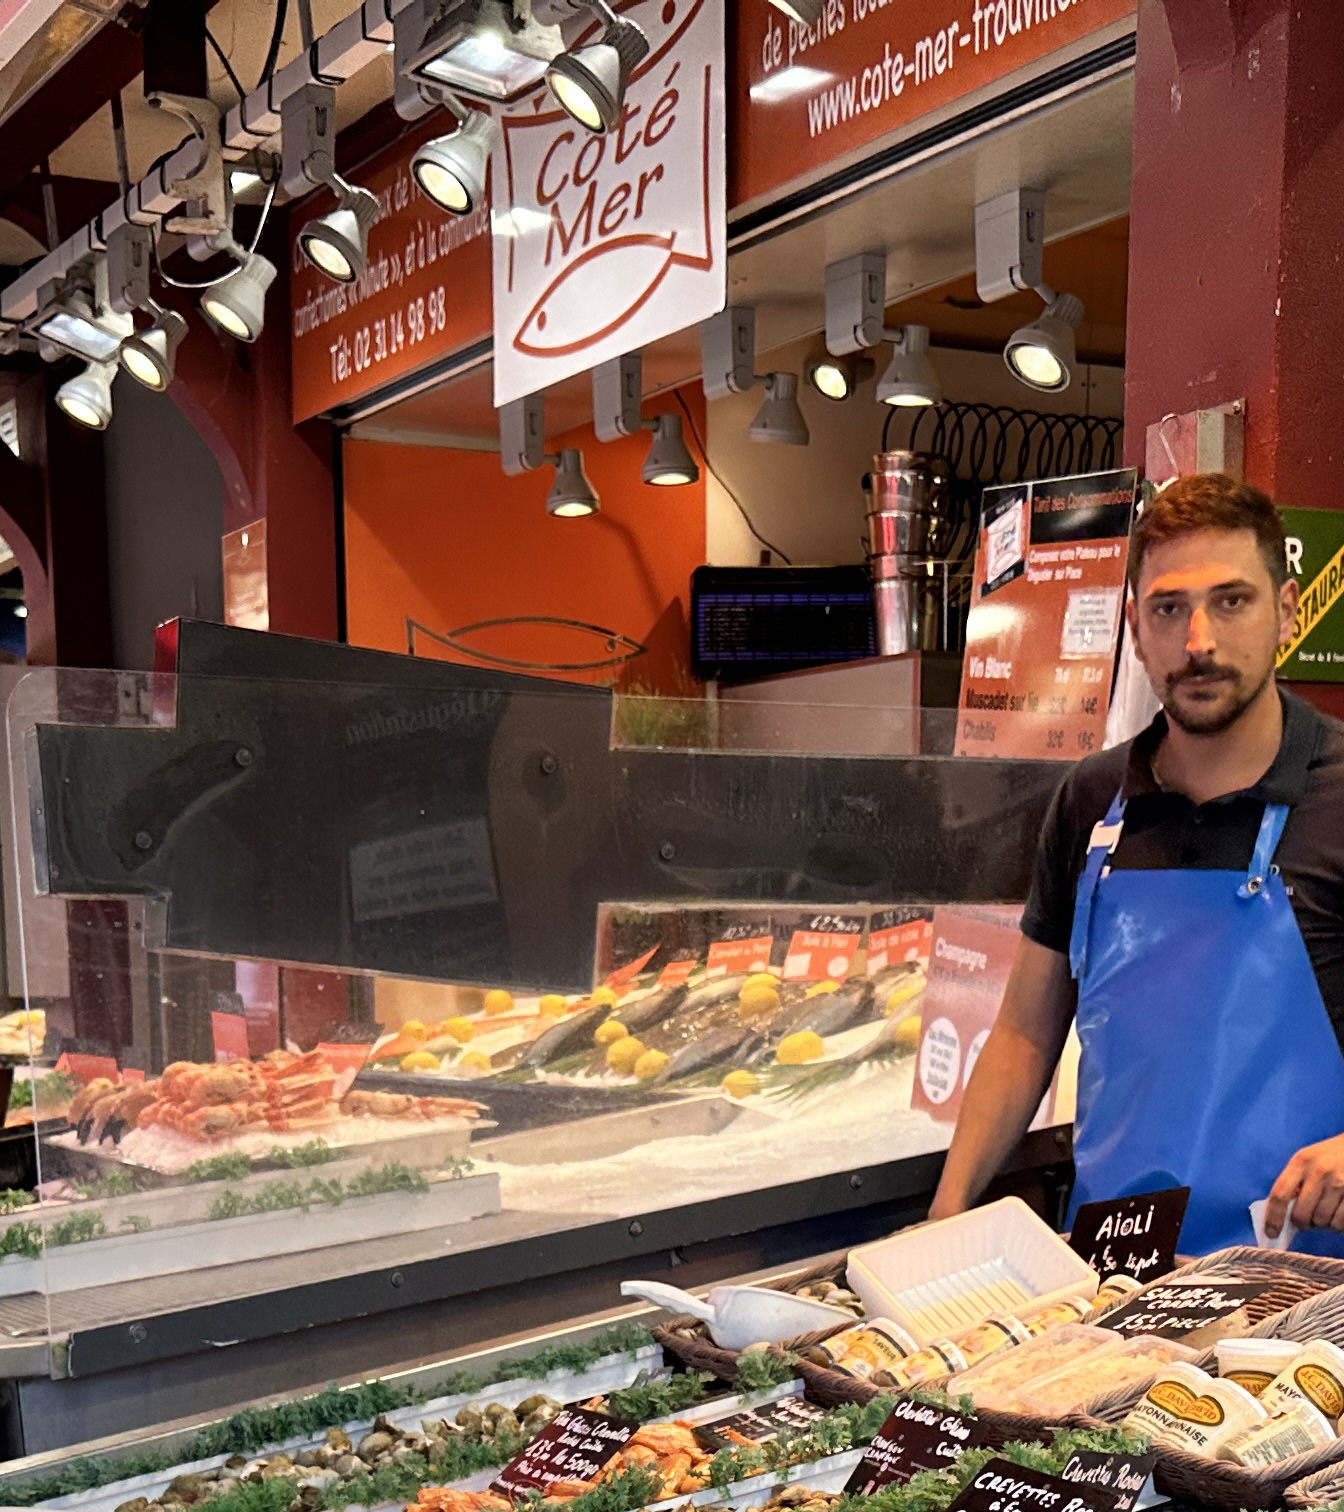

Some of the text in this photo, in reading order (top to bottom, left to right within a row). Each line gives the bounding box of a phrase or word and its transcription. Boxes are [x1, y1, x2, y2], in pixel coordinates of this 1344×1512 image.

[762, 15, 782, 72] de
[545, 163, 663, 267] Mer
[355, 327, 372, 373] 02
[374, 319, 388, 362] 31
[390, 310, 405, 353] 14
[408, 296, 426, 345] 98
[428, 286, 446, 336] 98
[969, 655, 1012, 679] Vin Blanc
[966, 688, 1009, 711] Muscadet
[1314, 1379, 1343, 1415] DAVID
